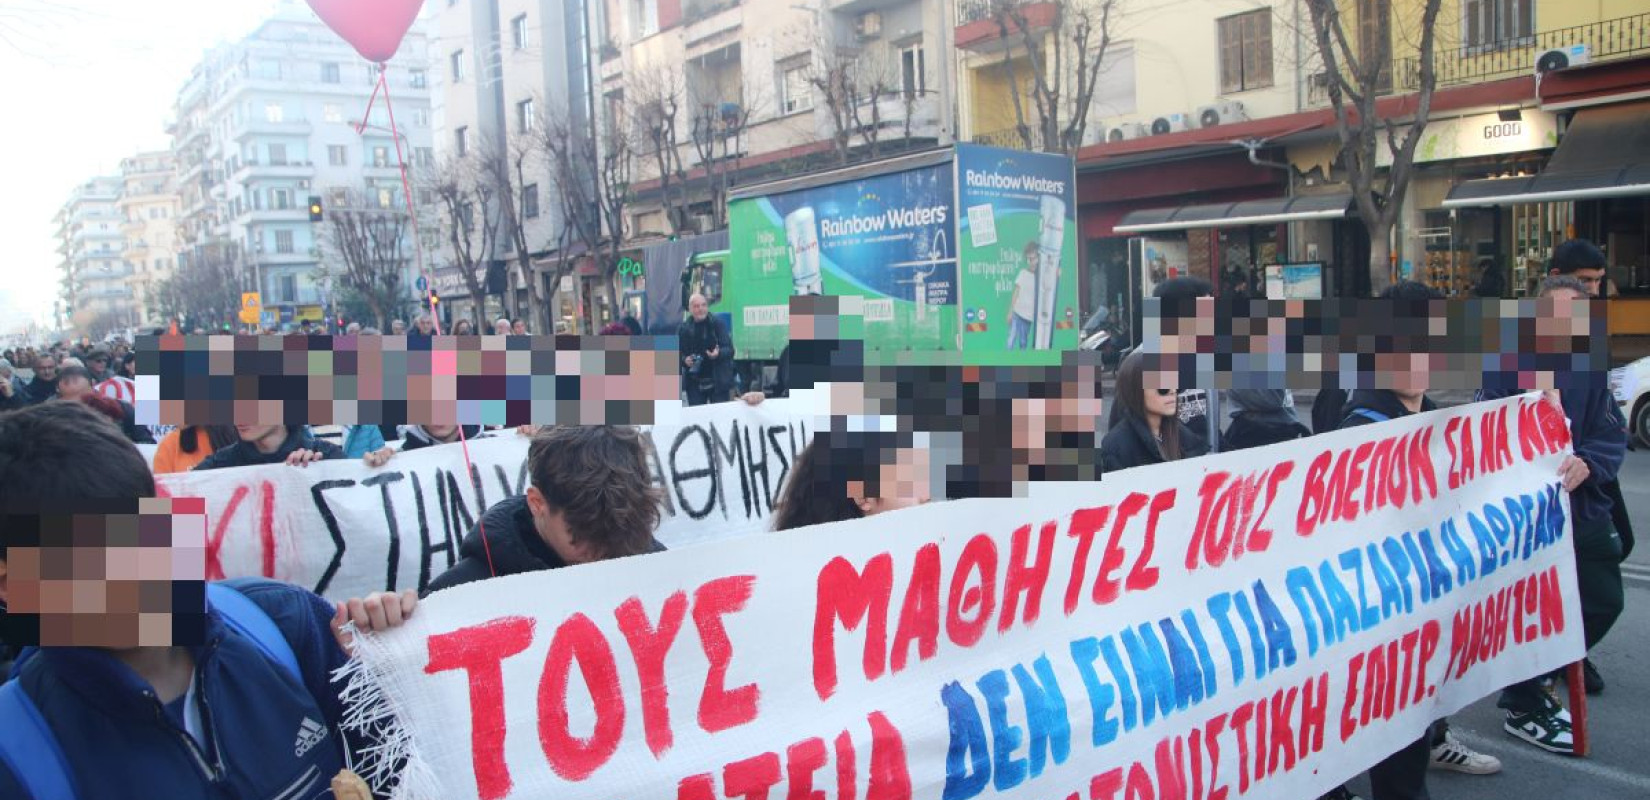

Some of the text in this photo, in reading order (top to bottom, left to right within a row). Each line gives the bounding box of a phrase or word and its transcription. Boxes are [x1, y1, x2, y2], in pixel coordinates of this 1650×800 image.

[1484, 122, 1522, 140] GOOD
[966, 169, 1021, 191] Rainbow
[1022, 174, 1064, 195] Waters
[821, 213, 886, 238] Rainbow
[886, 204, 947, 229] Waters
[424, 574, 761, 800] ΤΟΥΣ
[812, 487, 1177, 702] ΜΑΘΗΤΕΣ
[1184, 460, 1295, 571] ΤΟΥΣ
[1296, 425, 1438, 537] ΒΛΕΠΟΝ
[1444, 415, 1475, 490] ΣΑ
[1480, 405, 1513, 478] ΝΑ
[940, 652, 1072, 800] ΔΕΝ
[1070, 608, 1217, 749] ΕΙΝΑΙ
[1285, 528, 1453, 658] ΠΑΖΑΡΙΑ
[1440, 516, 1476, 587] Η
[1467, 481, 1566, 577] ΔΩΡΕΑΝ
[1340, 619, 1441, 743] ΕΠΙΤΡ.
[1443, 565, 1564, 686] ΜΑΘΗΤΩΝ
[295, 725, 328, 758] adidas
